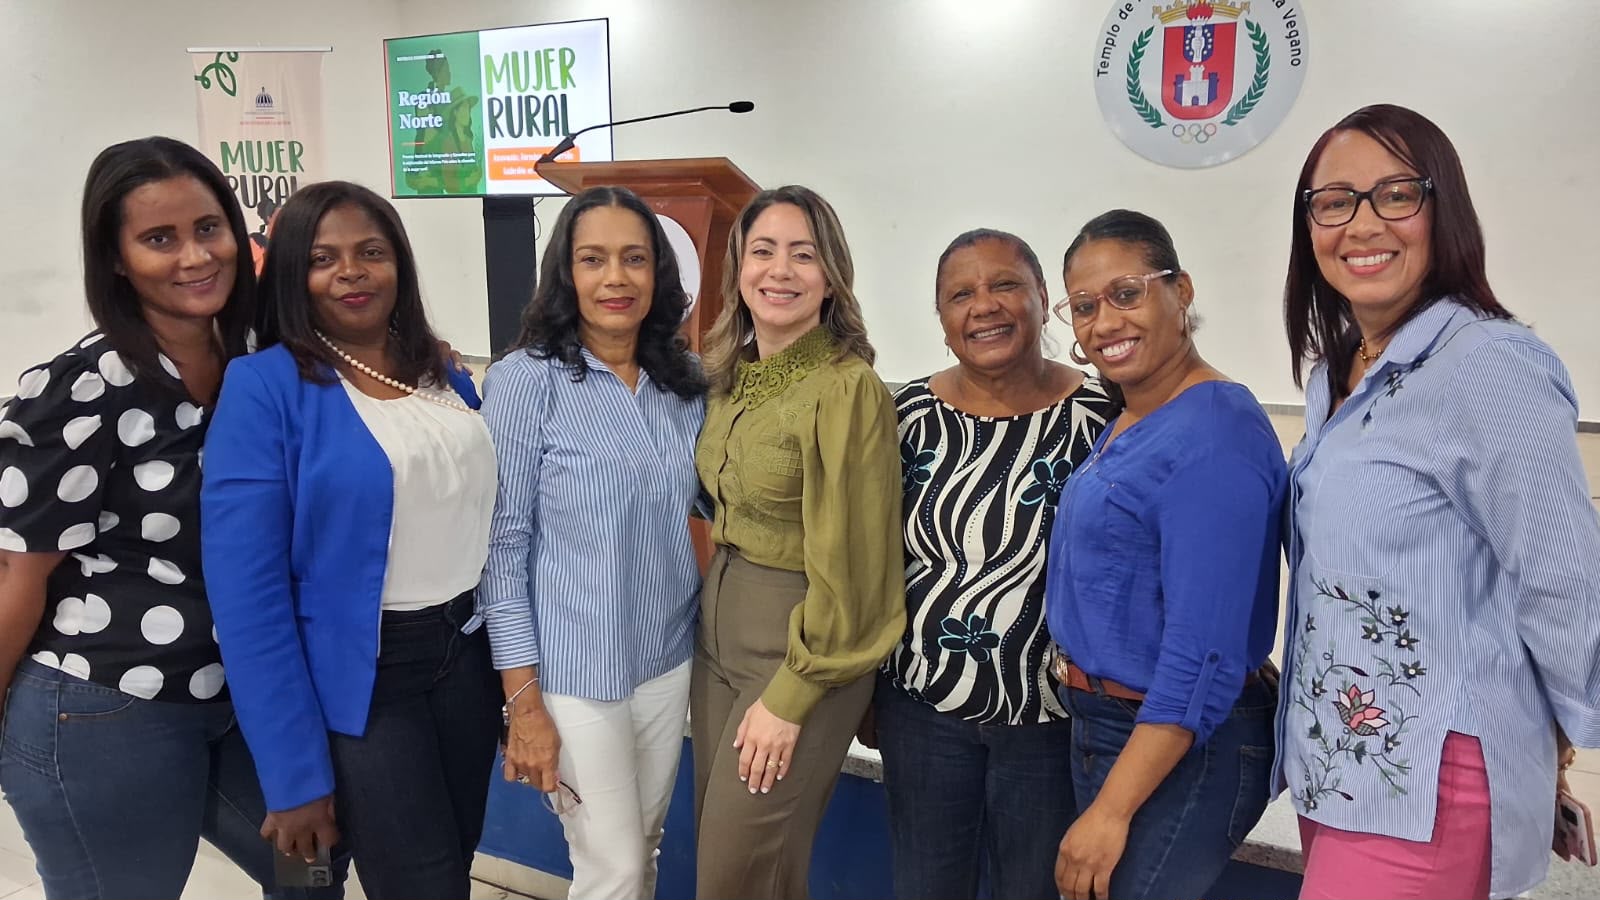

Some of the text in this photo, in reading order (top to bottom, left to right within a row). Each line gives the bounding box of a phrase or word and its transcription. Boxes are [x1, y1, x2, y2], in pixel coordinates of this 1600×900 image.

[1097, 3, 1301, 77] Templo de Vegano
[484, 47, 576, 95] MUJER
[398, 87, 451, 109] Región
[487, 93, 570, 139] RURAL
[399, 114, 443, 129] Norte
[220, 140, 304, 173] MUJER
